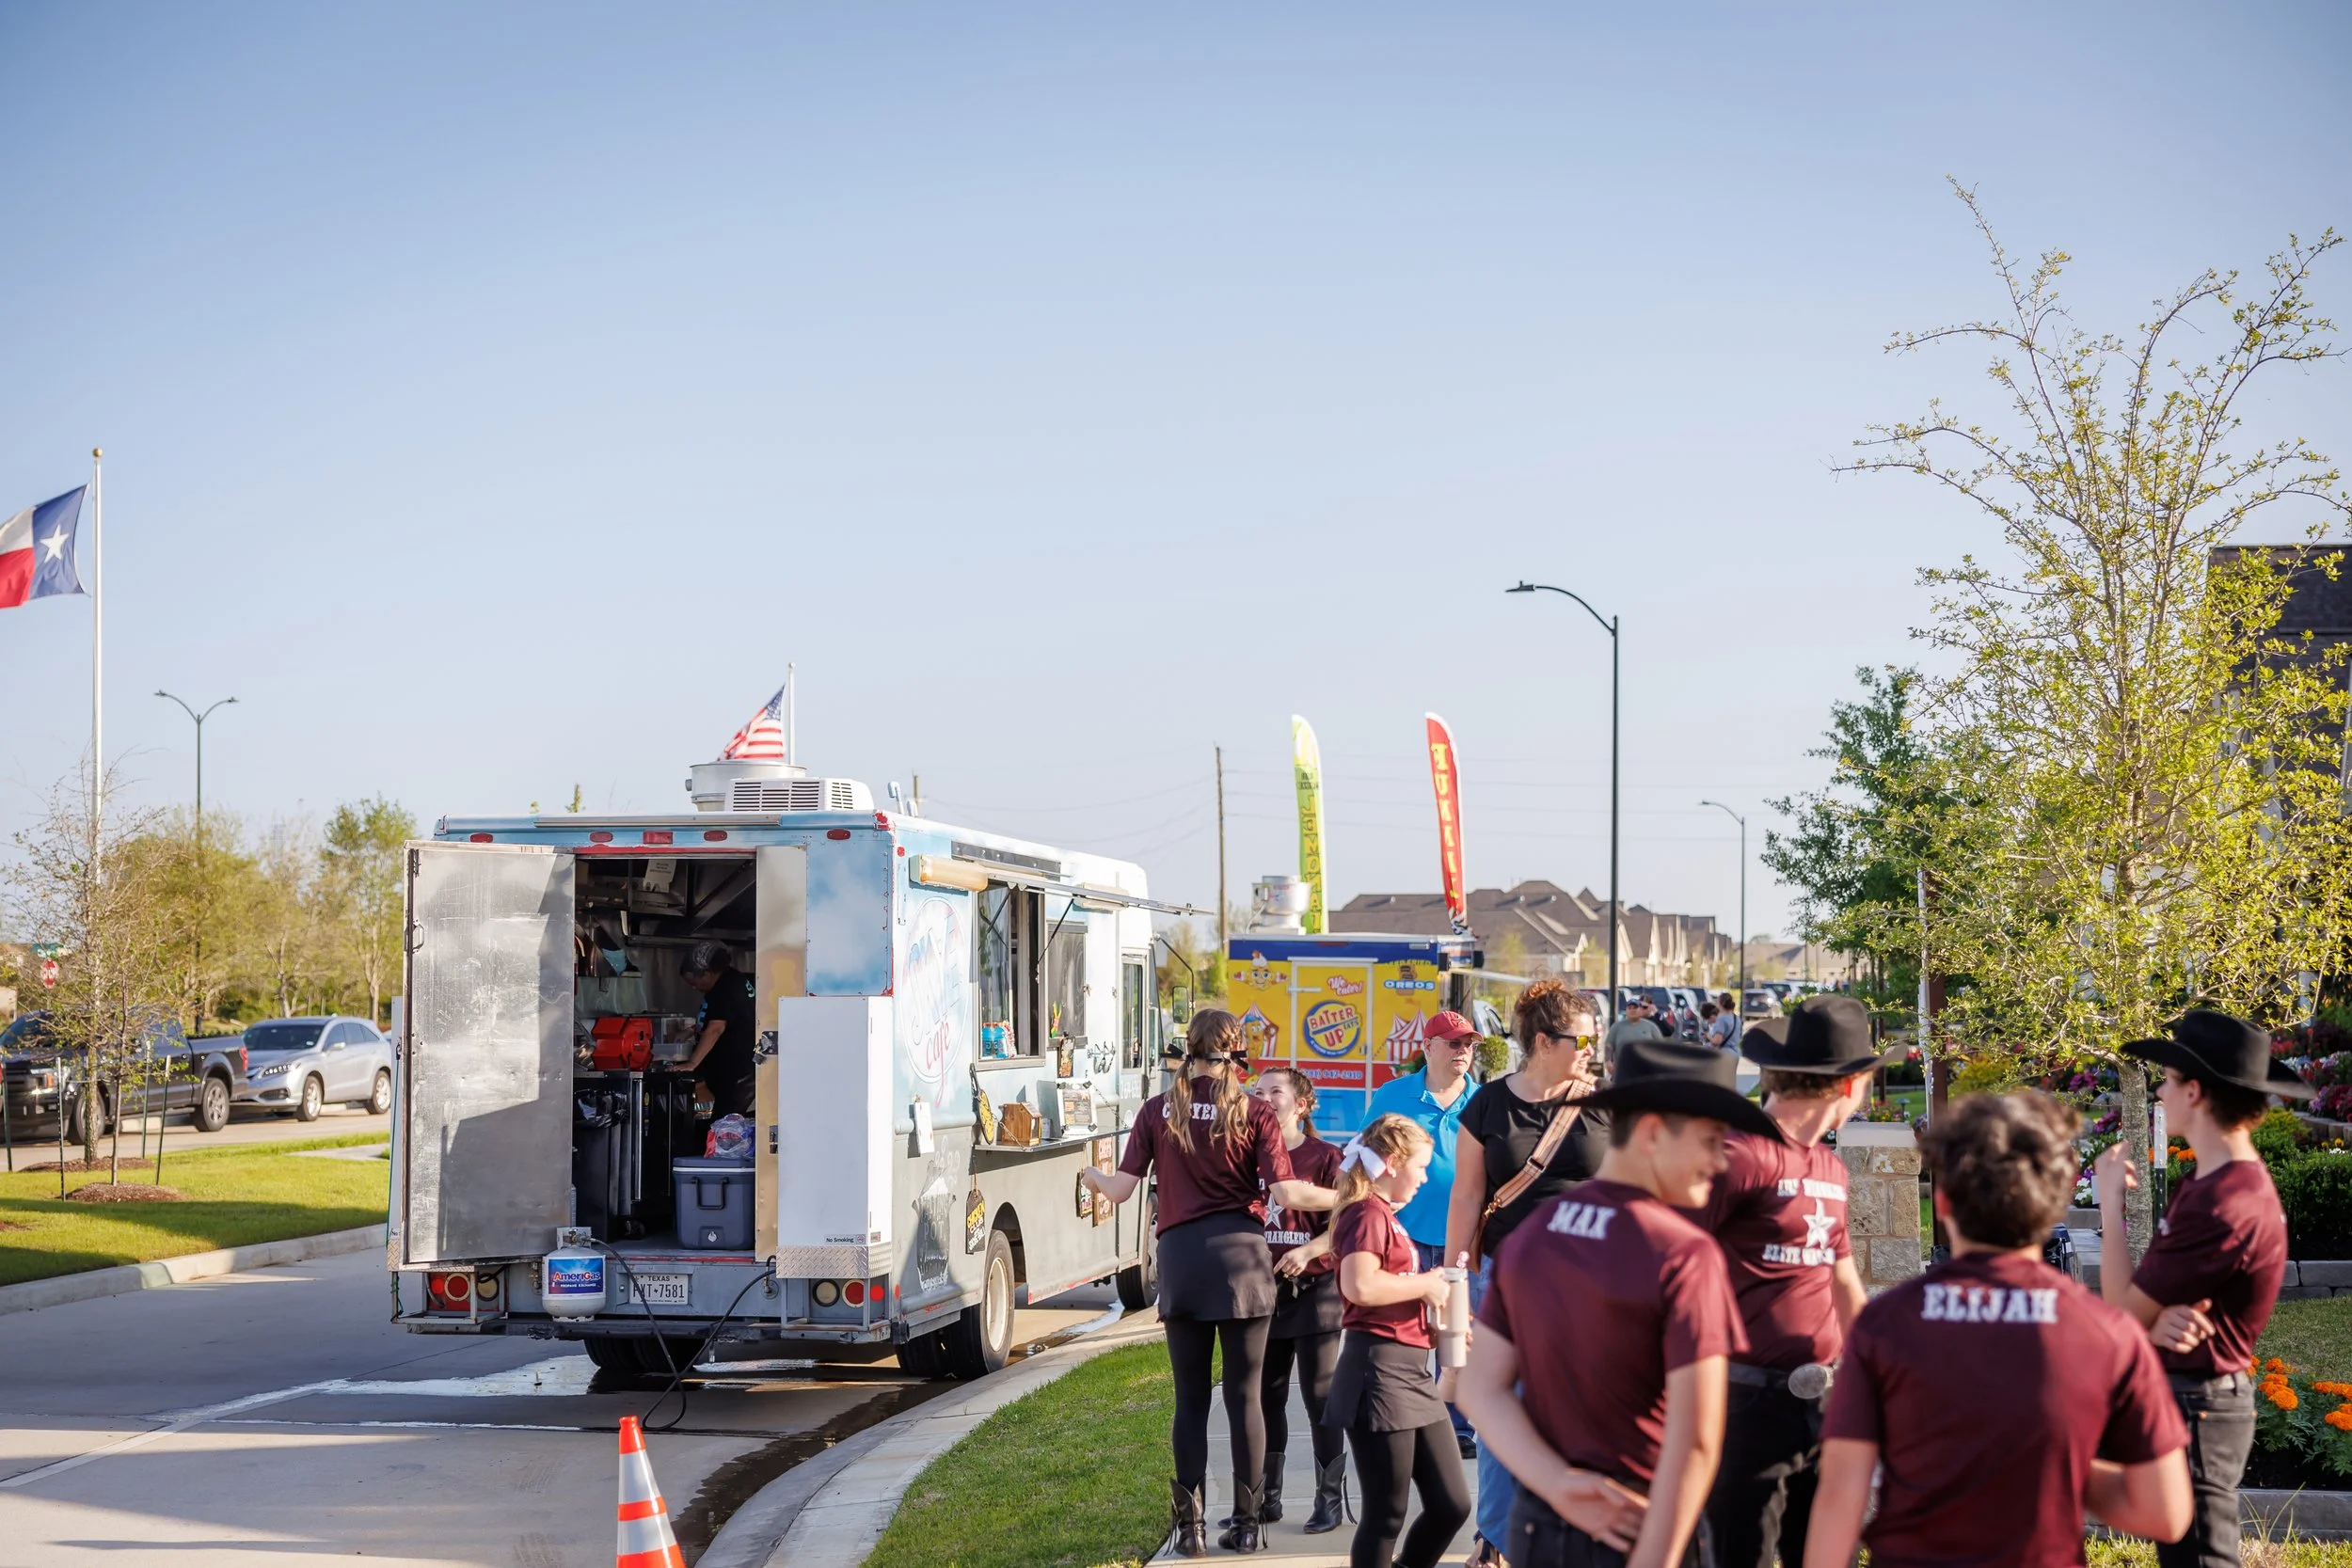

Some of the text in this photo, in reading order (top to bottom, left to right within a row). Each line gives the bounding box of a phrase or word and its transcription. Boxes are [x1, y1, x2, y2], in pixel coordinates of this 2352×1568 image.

[1385, 980, 1435, 991] OREOS
[1310, 1007, 1354, 1029] BATTER
[1324, 1028, 1343, 1047] UP
[1264, 1230, 1311, 1244] RANGLERS
[553, 1271, 601, 1281] AmeriGas
[1921, 1282, 2059, 1324] ELIJAH
